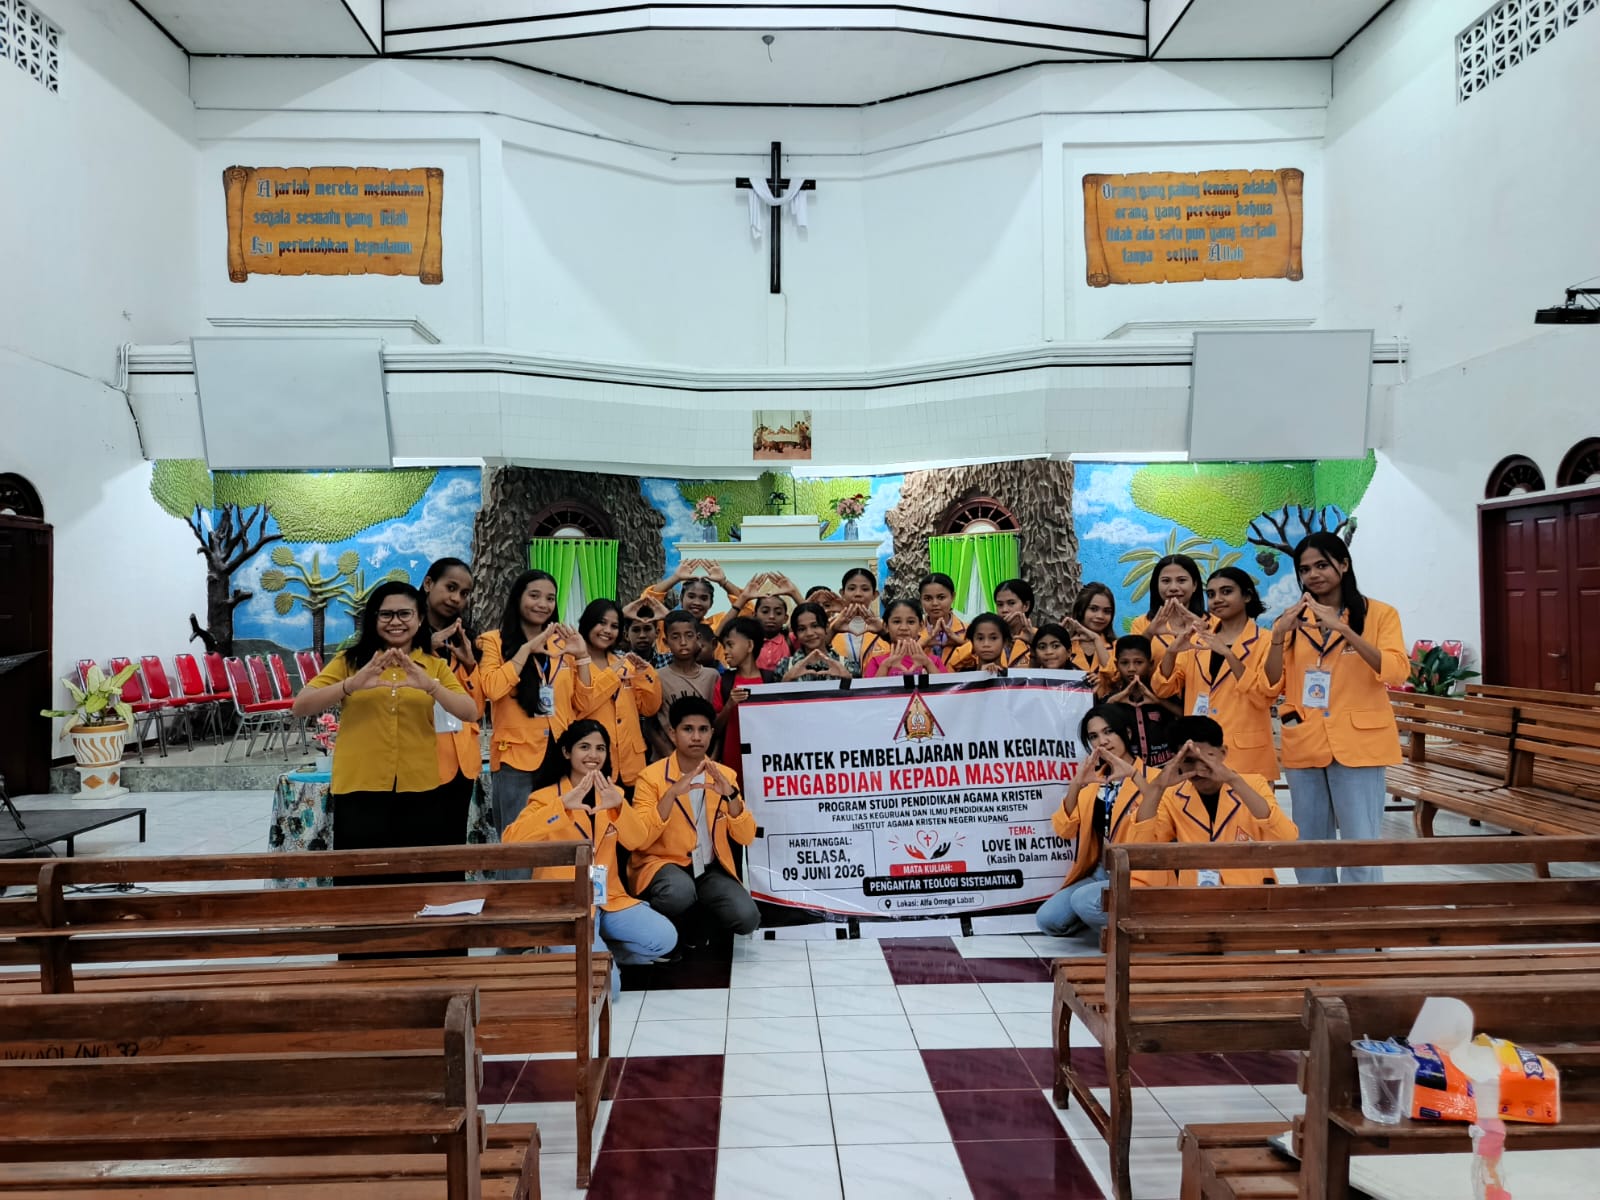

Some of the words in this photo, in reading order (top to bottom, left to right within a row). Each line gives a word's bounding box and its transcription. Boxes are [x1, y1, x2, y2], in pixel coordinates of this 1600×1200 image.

[315, 180, 358, 196] mereka
[1242, 179, 1277, 196] adalah
[253, 208, 291, 228] segala
[345, 212, 373, 228] yang
[1115, 207, 1148, 221] orang
[1155, 206, 1181, 221] yang
[1186, 205, 1231, 220] percaya
[1237, 200, 1272, 218] bahwa
[1106, 226, 1133, 242] tidak
[1136, 226, 1155, 241] ada
[1159, 225, 1183, 241] satu
[1185, 228, 1206, 244] pun
[1210, 227, 1236, 242] yang
[1122, 247, 1153, 266] tanpa
[762, 751, 835, 772] PRAKTEK
[840, 743, 964, 769] PEMBELAJARAN
[969, 741, 997, 760] DAN
[1004, 738, 1077, 759] KEGIATAN
[763, 770, 882, 797] PENGABDIAN
[889, 766, 961, 791] KEPADA
[965, 760, 1079, 785] MASYARAKAT
[818, 800, 868, 813] PROGRAM
[870, 798, 899, 811] STUDI
[901, 794, 961, 809] PENDIDIKAN
[963, 791, 999, 804] AGAMA
[1001, 789, 1043, 801] KRISTEN
[832, 813, 868, 822] FAKULTAS
[870, 811, 910, 820] KEGURUAN
[912, 809, 927, 817] DAN
[929, 808, 948, 816] ILMU
[950, 805, 995, 815] PENDIDIKAN
[997, 803, 1028, 813] KRISTEN
[852, 822, 886, 830] INSTITUT
[887, 820, 913, 828] AGAMA
[916, 819, 947, 827] KRISTEN
[949, 817, 976, 825] NEGERI
[978, 815, 1009, 824] KUPANG
[1009, 826, 1036, 836] TEMA:
[788, 836, 852, 848] HARI/TANGGAL:
[982, 839, 1011, 852] LOVE
[1016, 837, 1027, 850] IN
[1031, 835, 1071, 849] ACTION
[797, 850, 851, 865] SELASA,
[987, 854, 1017, 866] (Kasih
[1019, 852, 1048, 863] Dalam
[1051, 850, 1074, 861] Aksi)
[782, 868, 798, 881] 09
[801, 867, 832, 880] JUNI
[834, 864, 865, 878] 2026
[903, 866, 923, 874] MATA
[925, 864, 953, 874] KULIAH:
[870, 879, 922, 892] PENGANTAR
[924, 877, 959, 889] TEOLOGI
[961, 874, 1017, 887] SISTEMATIKA
[897, 899, 918, 908] Lokasi:
[934, 898, 955, 906] Omega
[957, 896, 975, 905] Labat
